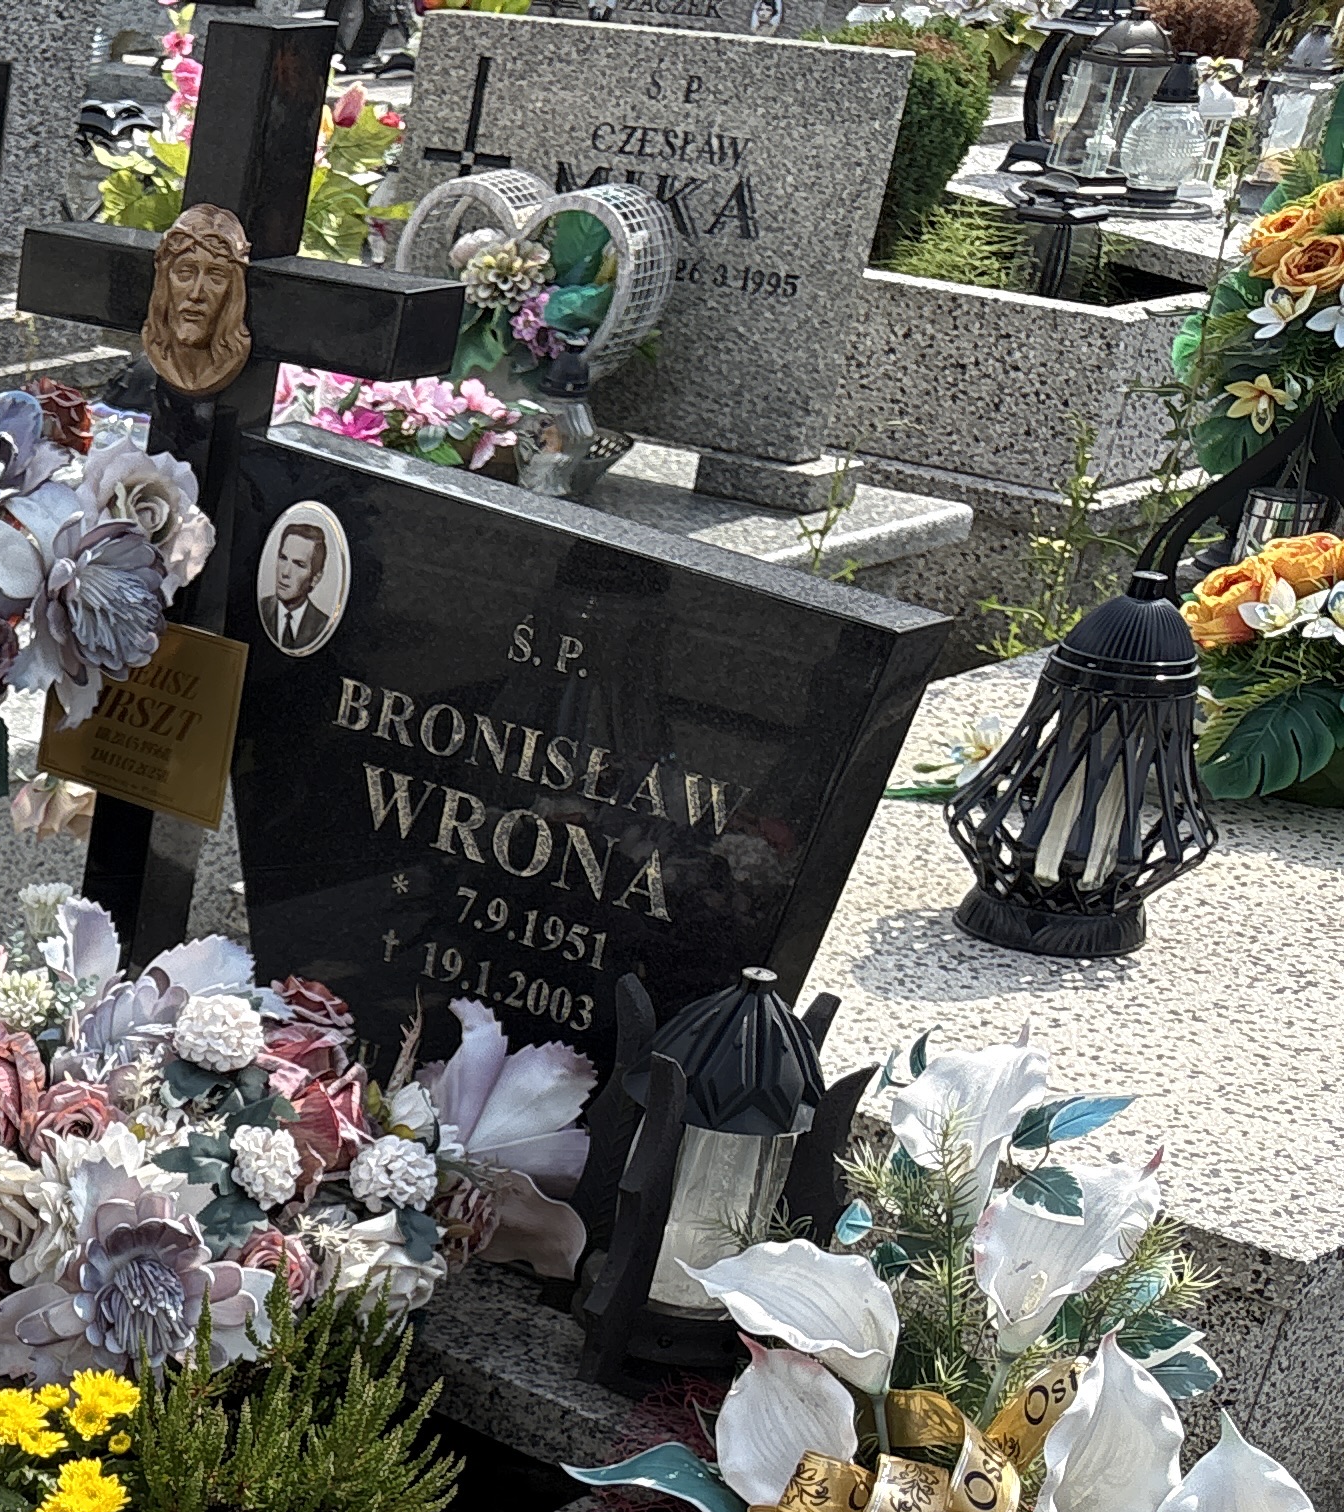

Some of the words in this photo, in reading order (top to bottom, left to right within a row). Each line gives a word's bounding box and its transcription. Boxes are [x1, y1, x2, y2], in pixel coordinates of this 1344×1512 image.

[591, 122, 753, 174] CZESŁAW
[555, 160, 760, 242] MKA
[555, 633, 589, 679] P.
[332, 677, 752, 837] BRONISŁAW
[362, 763, 673, 923] WRONA
[456, 886, 608, 972] 7.9.1951
[420, 941, 595, 1032] 19.1.2003
